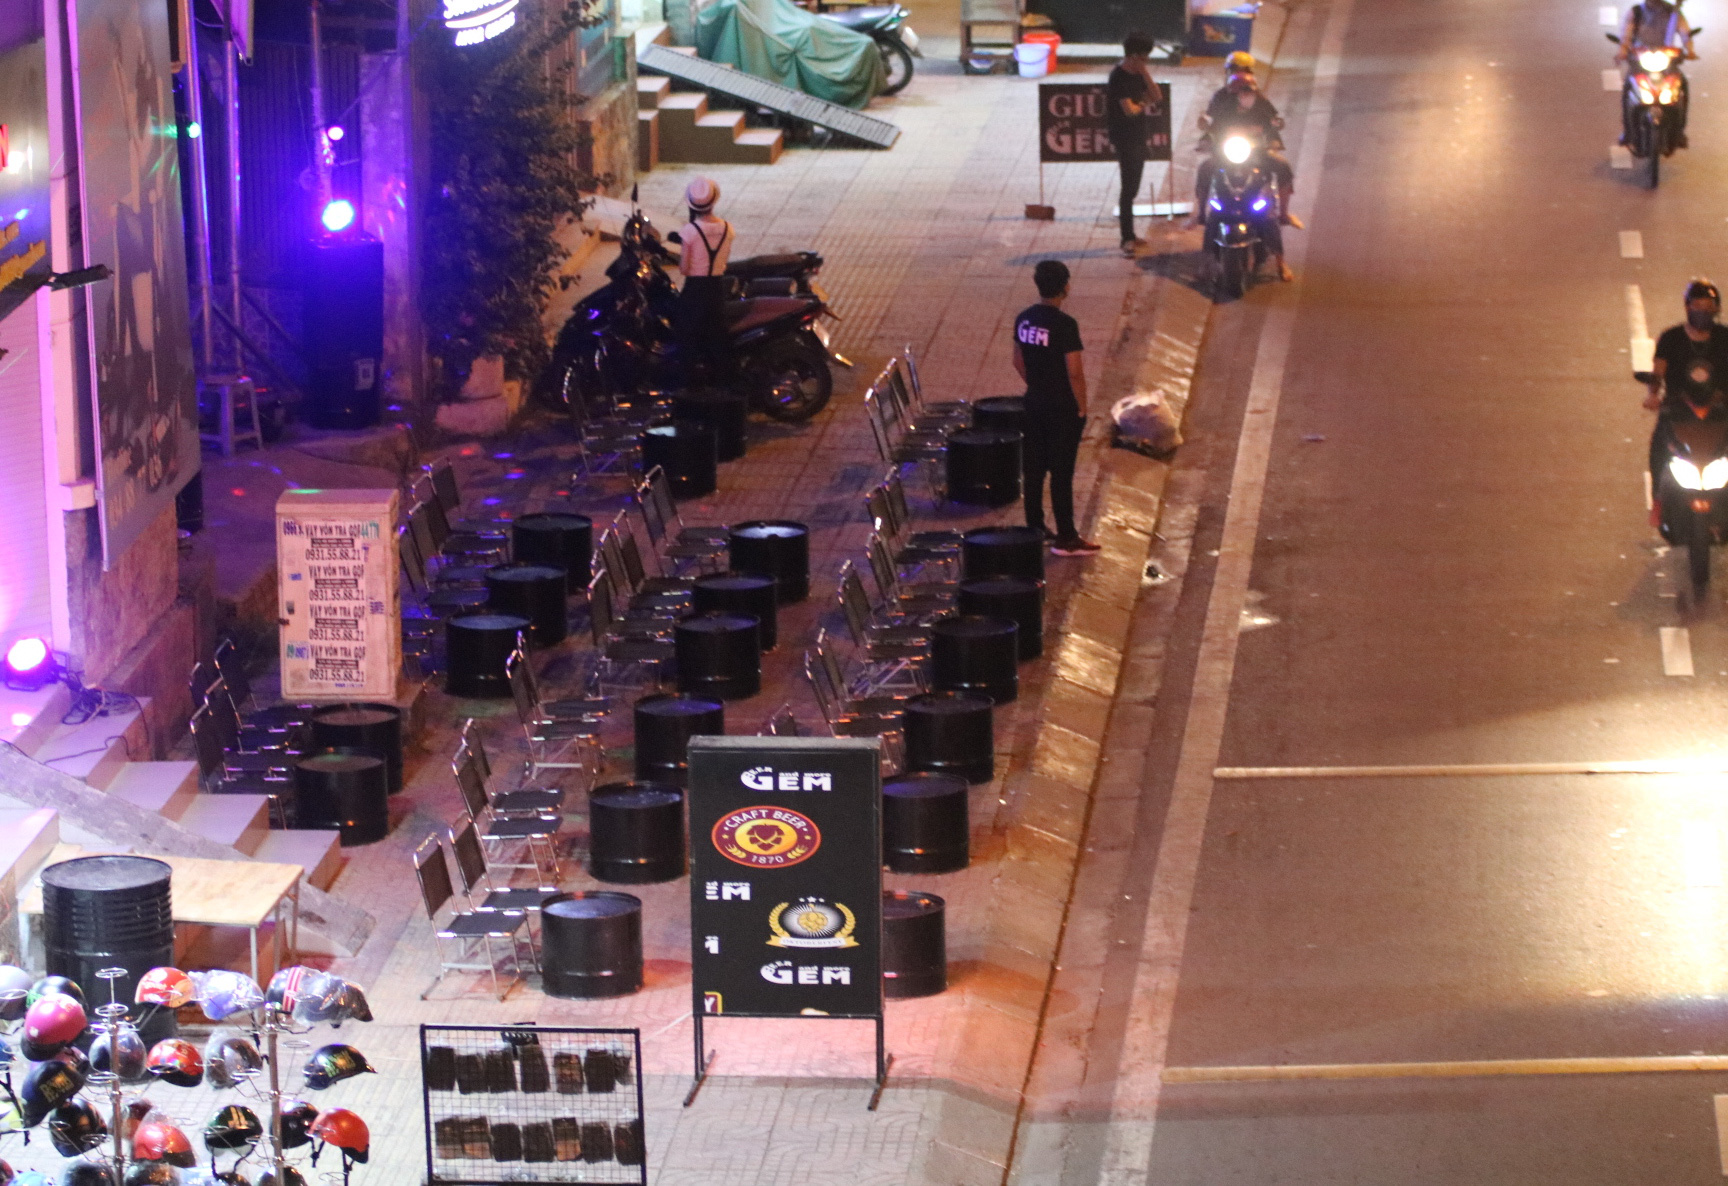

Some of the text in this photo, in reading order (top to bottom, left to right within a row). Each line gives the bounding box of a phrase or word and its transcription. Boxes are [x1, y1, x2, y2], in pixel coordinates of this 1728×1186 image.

[1018, 320, 1049, 347] GEM
[740, 768, 832, 791] GEM
[725, 809, 808, 831] CRAFT BEER
[751, 854, 784, 864] 1870
[760, 963, 851, 985] GEM
